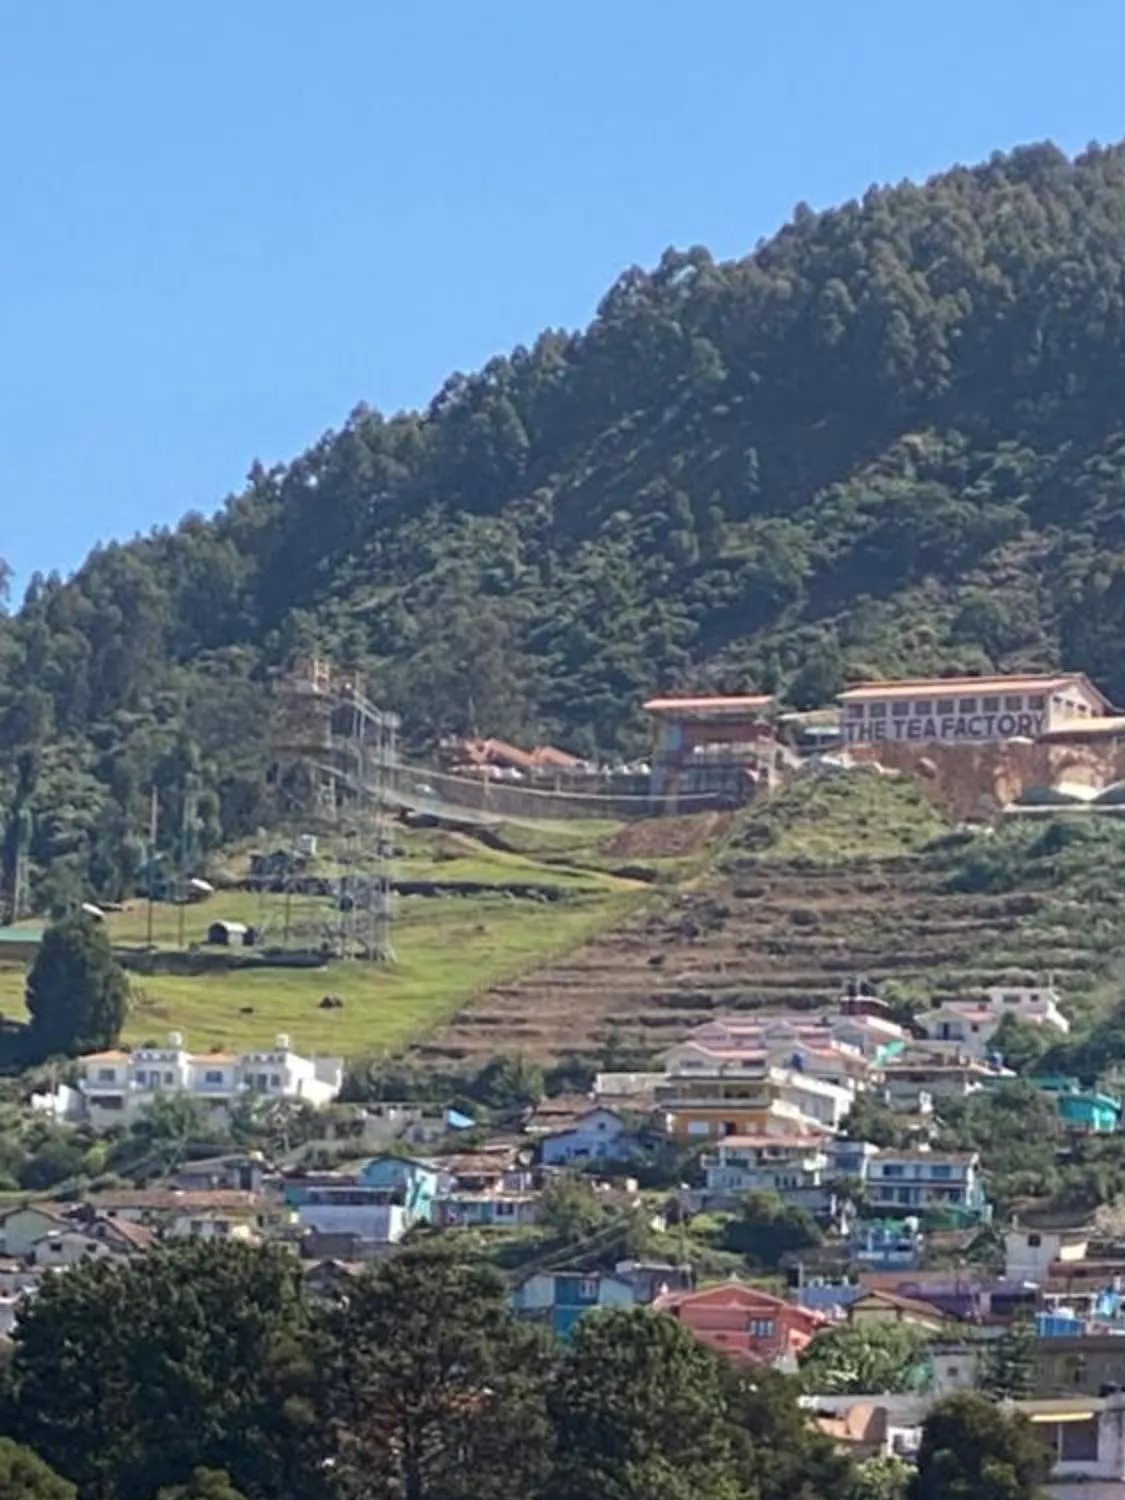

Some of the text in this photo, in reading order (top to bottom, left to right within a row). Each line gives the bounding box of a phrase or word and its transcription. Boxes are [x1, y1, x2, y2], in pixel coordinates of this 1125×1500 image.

[845, 713, 1047, 741] THE TEA FACTORY
